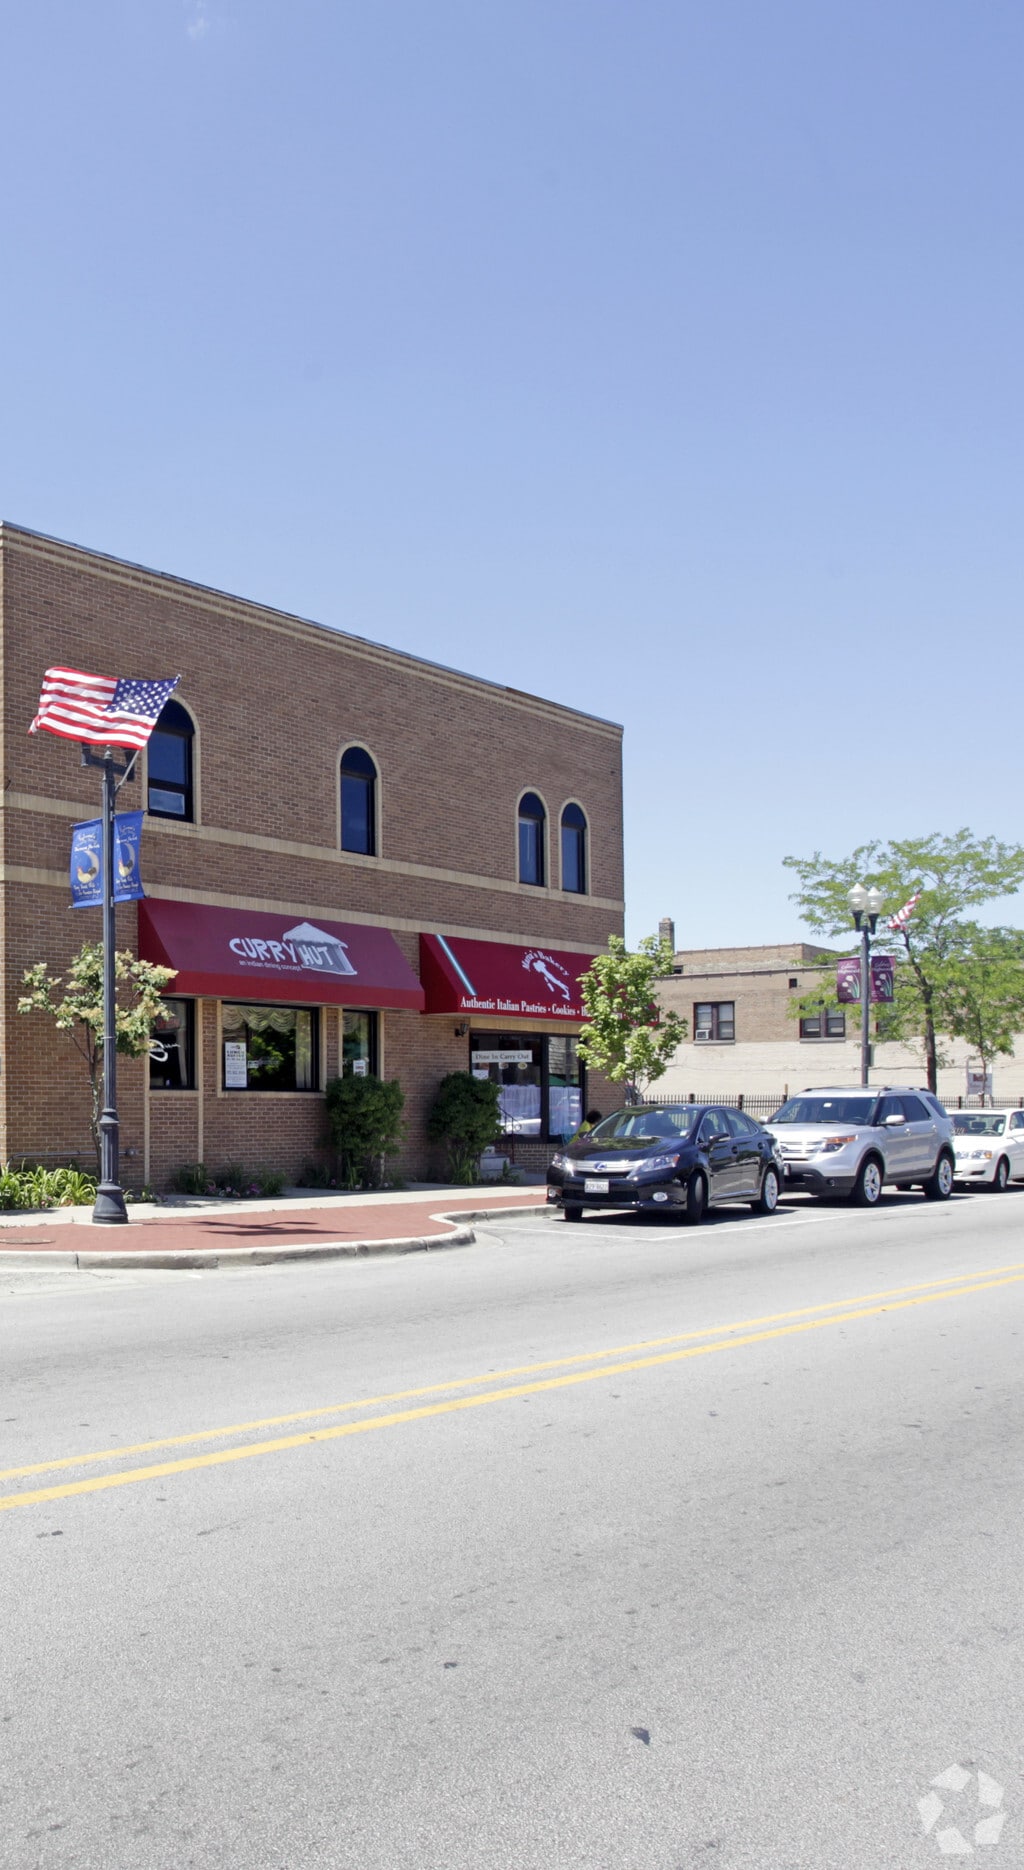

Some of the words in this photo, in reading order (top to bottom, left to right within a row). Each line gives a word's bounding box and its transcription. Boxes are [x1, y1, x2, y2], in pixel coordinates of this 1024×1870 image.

[229, 938, 297, 963] CURRY
[298, 945, 333, 965] HUT
[460, 996, 495, 1010] Authentic
[496, 998, 520, 1011] Italian
[521, 1001, 547, 1014] Pastries
[552, 1003, 576, 1016] Cookies
[499, 1053, 516, 1061] Carry
